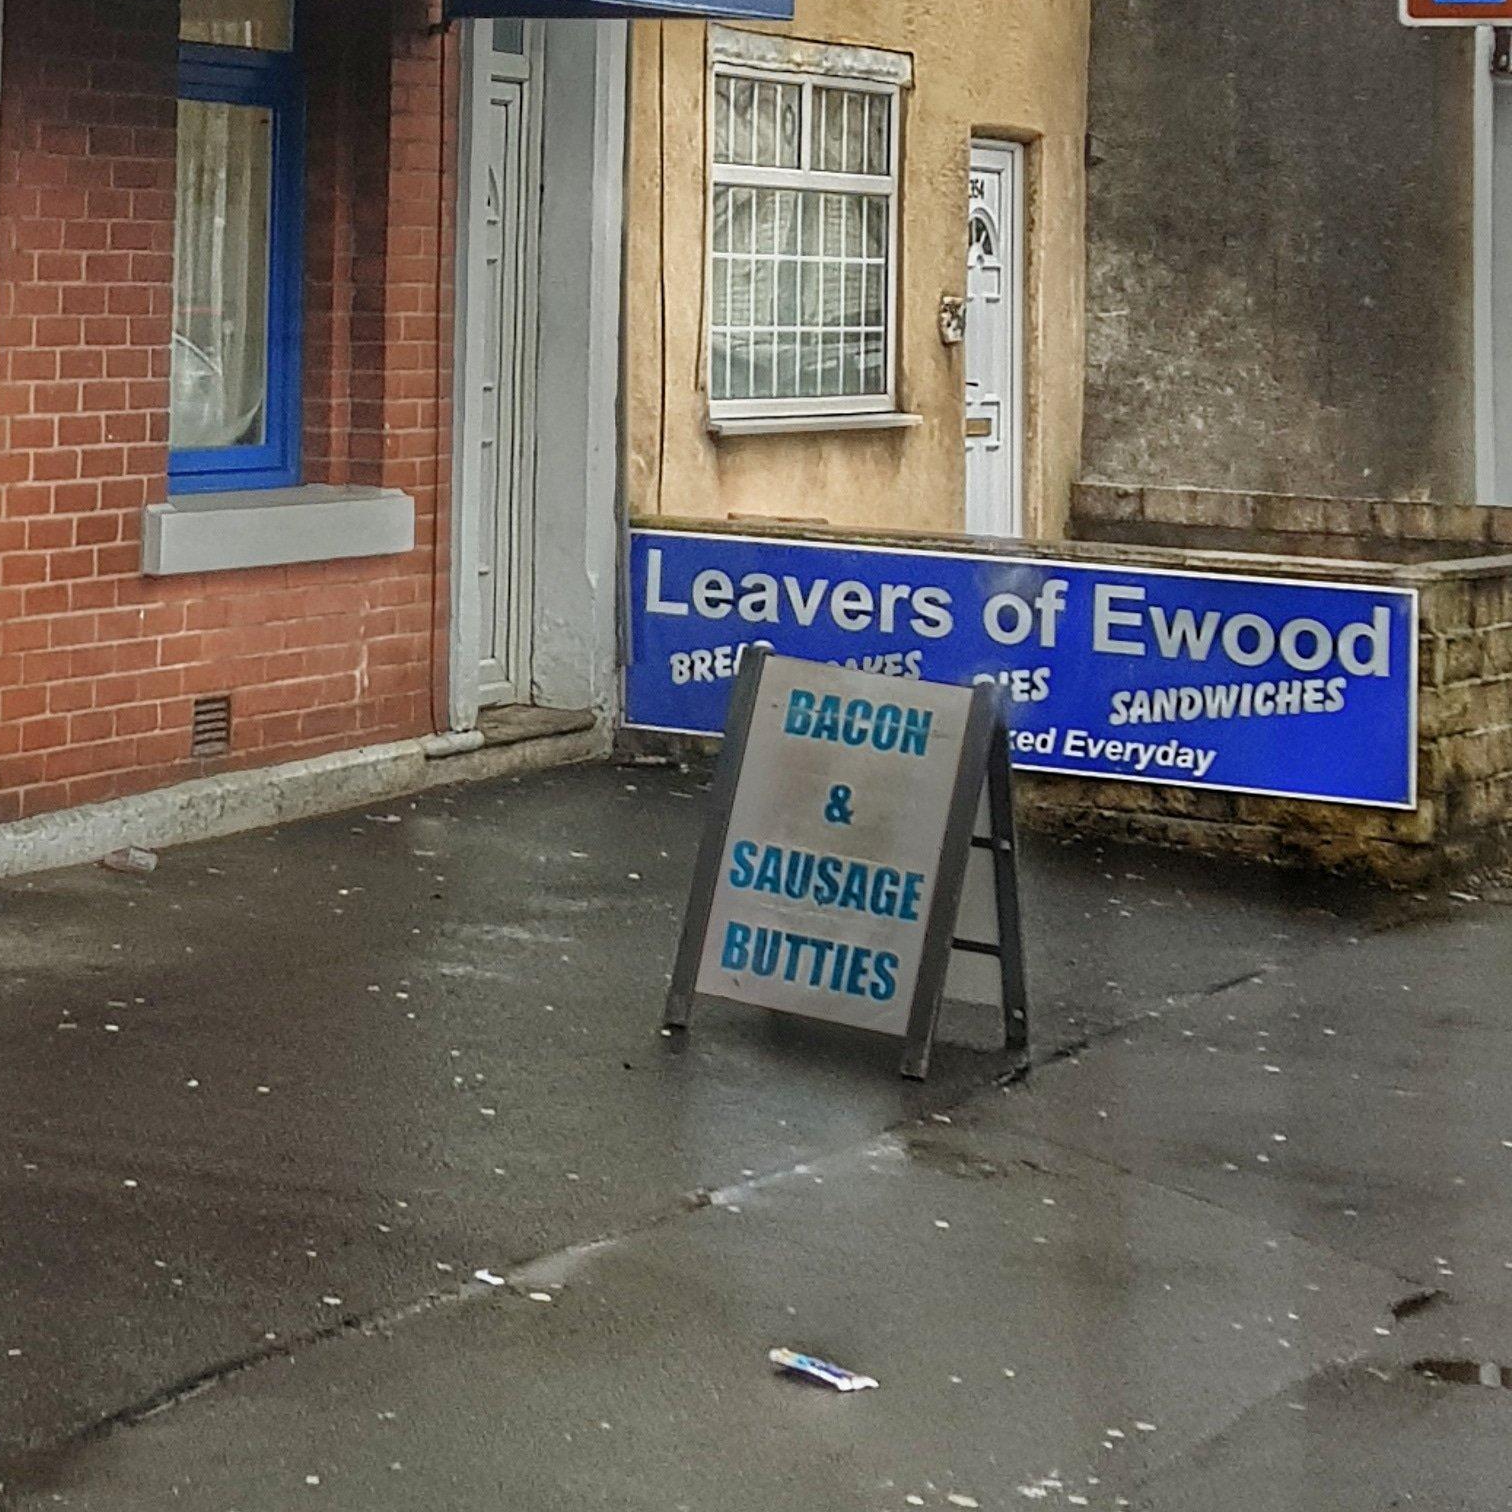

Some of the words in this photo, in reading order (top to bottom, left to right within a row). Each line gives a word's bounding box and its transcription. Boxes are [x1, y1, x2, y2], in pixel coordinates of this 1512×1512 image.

[644, 547, 954, 640] Leavers
[982, 577, 1069, 649] of
[1092, 583, 1392, 678] Ewood
[784, 688, 934, 756] BACON
[1109, 676, 1347, 726] SANDWICHES
[1063, 728, 1218, 777] Everyday
[824, 784, 855, 825] &
[729, 839, 925, 922] SAUSAGE
[720, 919, 899, 1002] BUTTIES
